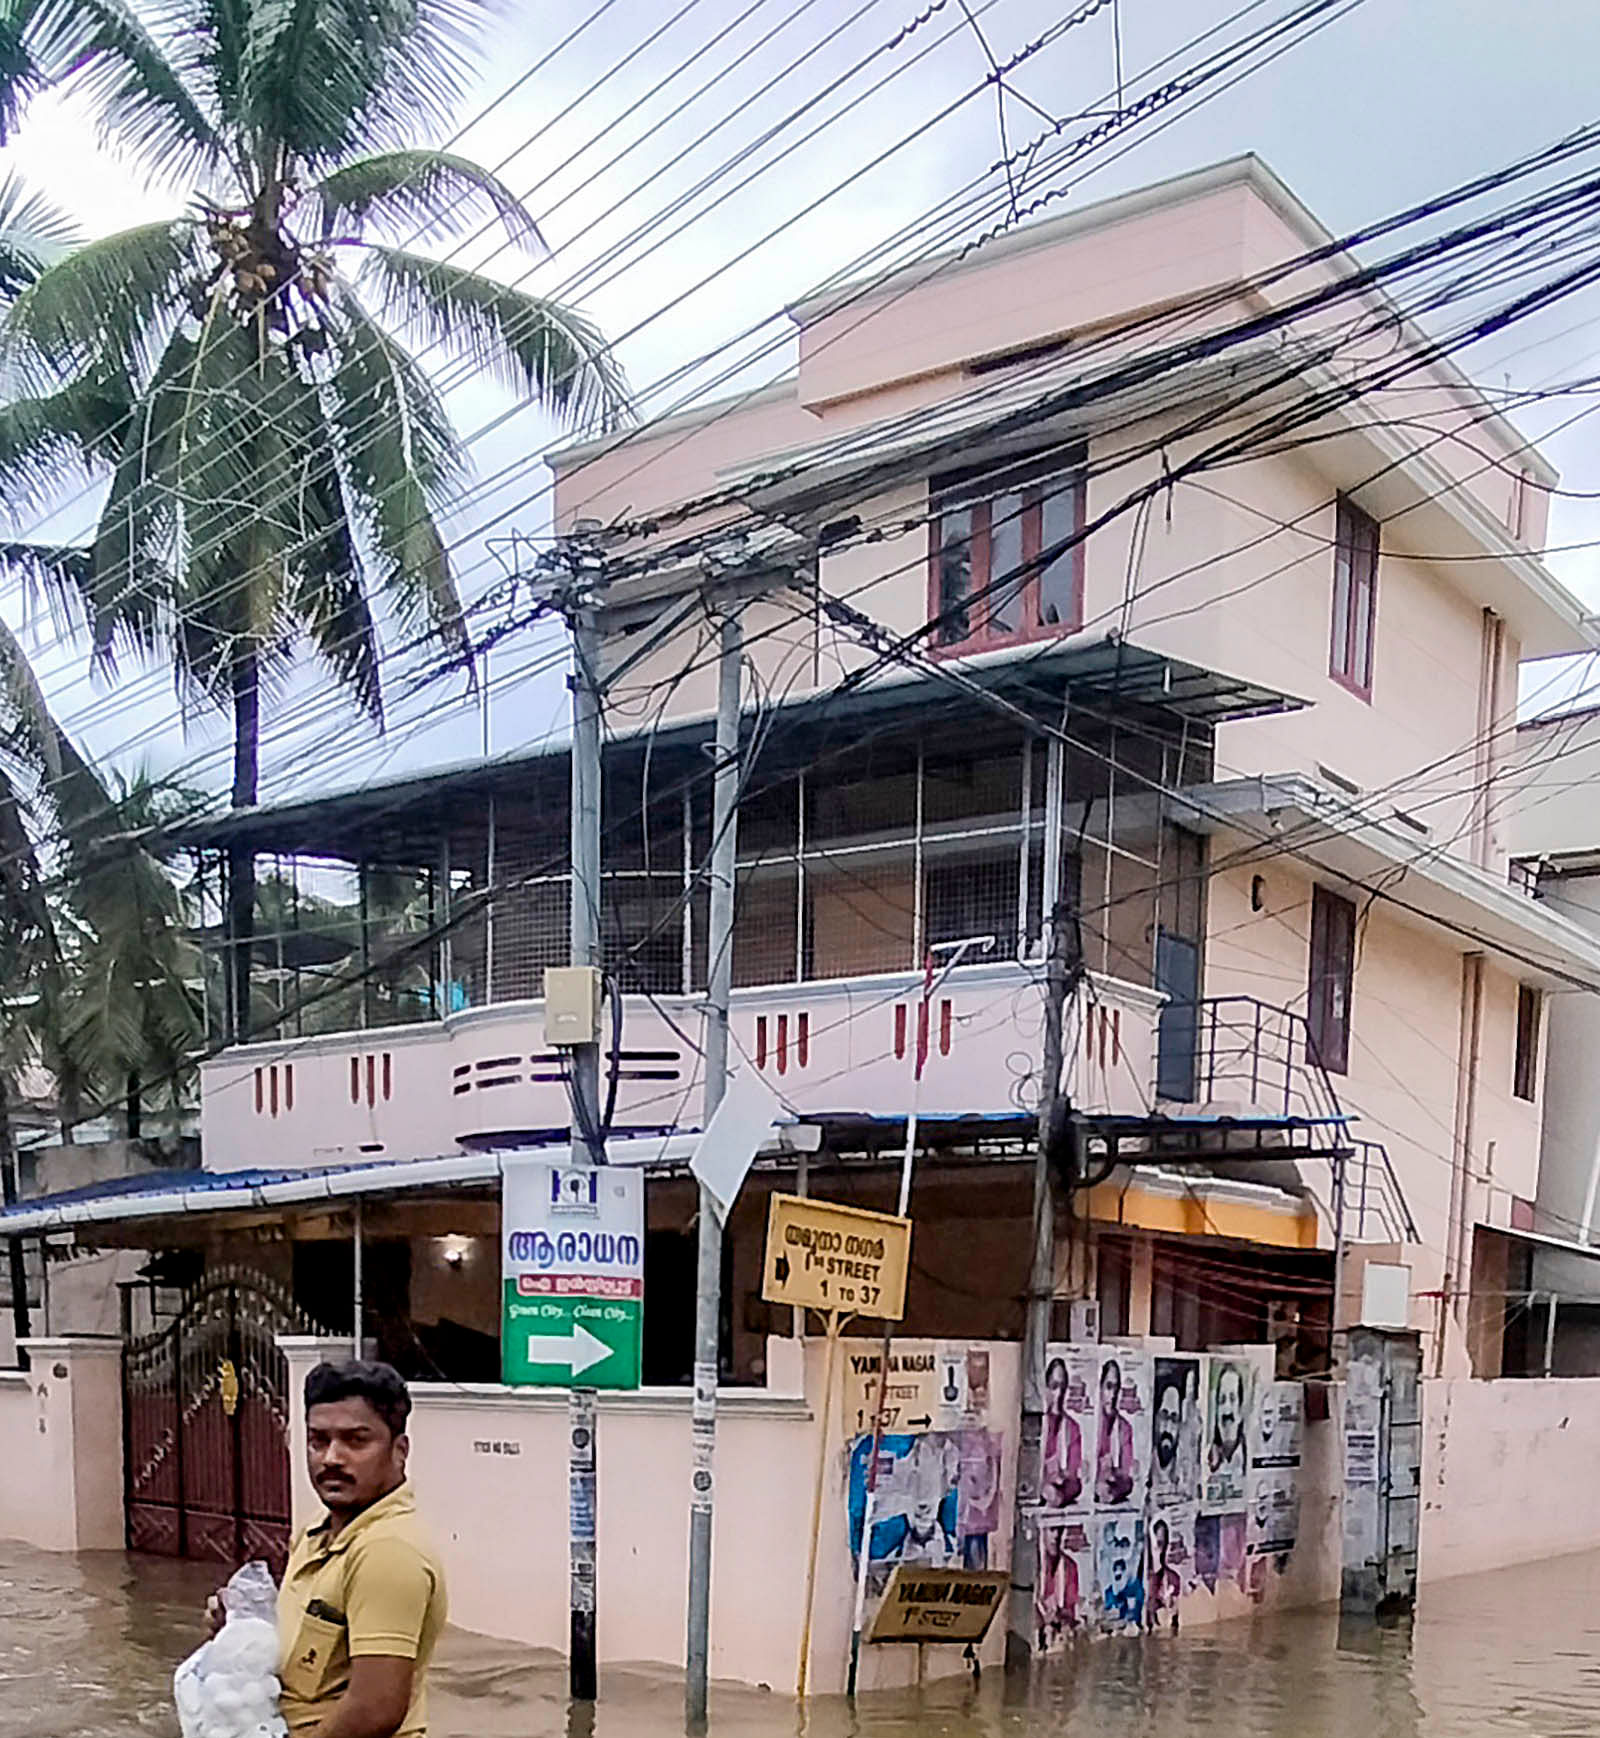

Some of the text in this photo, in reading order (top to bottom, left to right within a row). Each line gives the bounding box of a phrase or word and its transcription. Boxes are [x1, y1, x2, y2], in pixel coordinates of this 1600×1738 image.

[509, 1231, 639, 1269] ആരാധന
[826, 1257, 881, 1282] STREET
[820, 1279, 881, 1305] 1 TO 37
[902, 1354, 935, 1372] NAGAR
[857, 1409, 864, 1428] 1
[880, 1408, 900, 1427] 37
[950, 1582, 998, 1605] NAGAR
